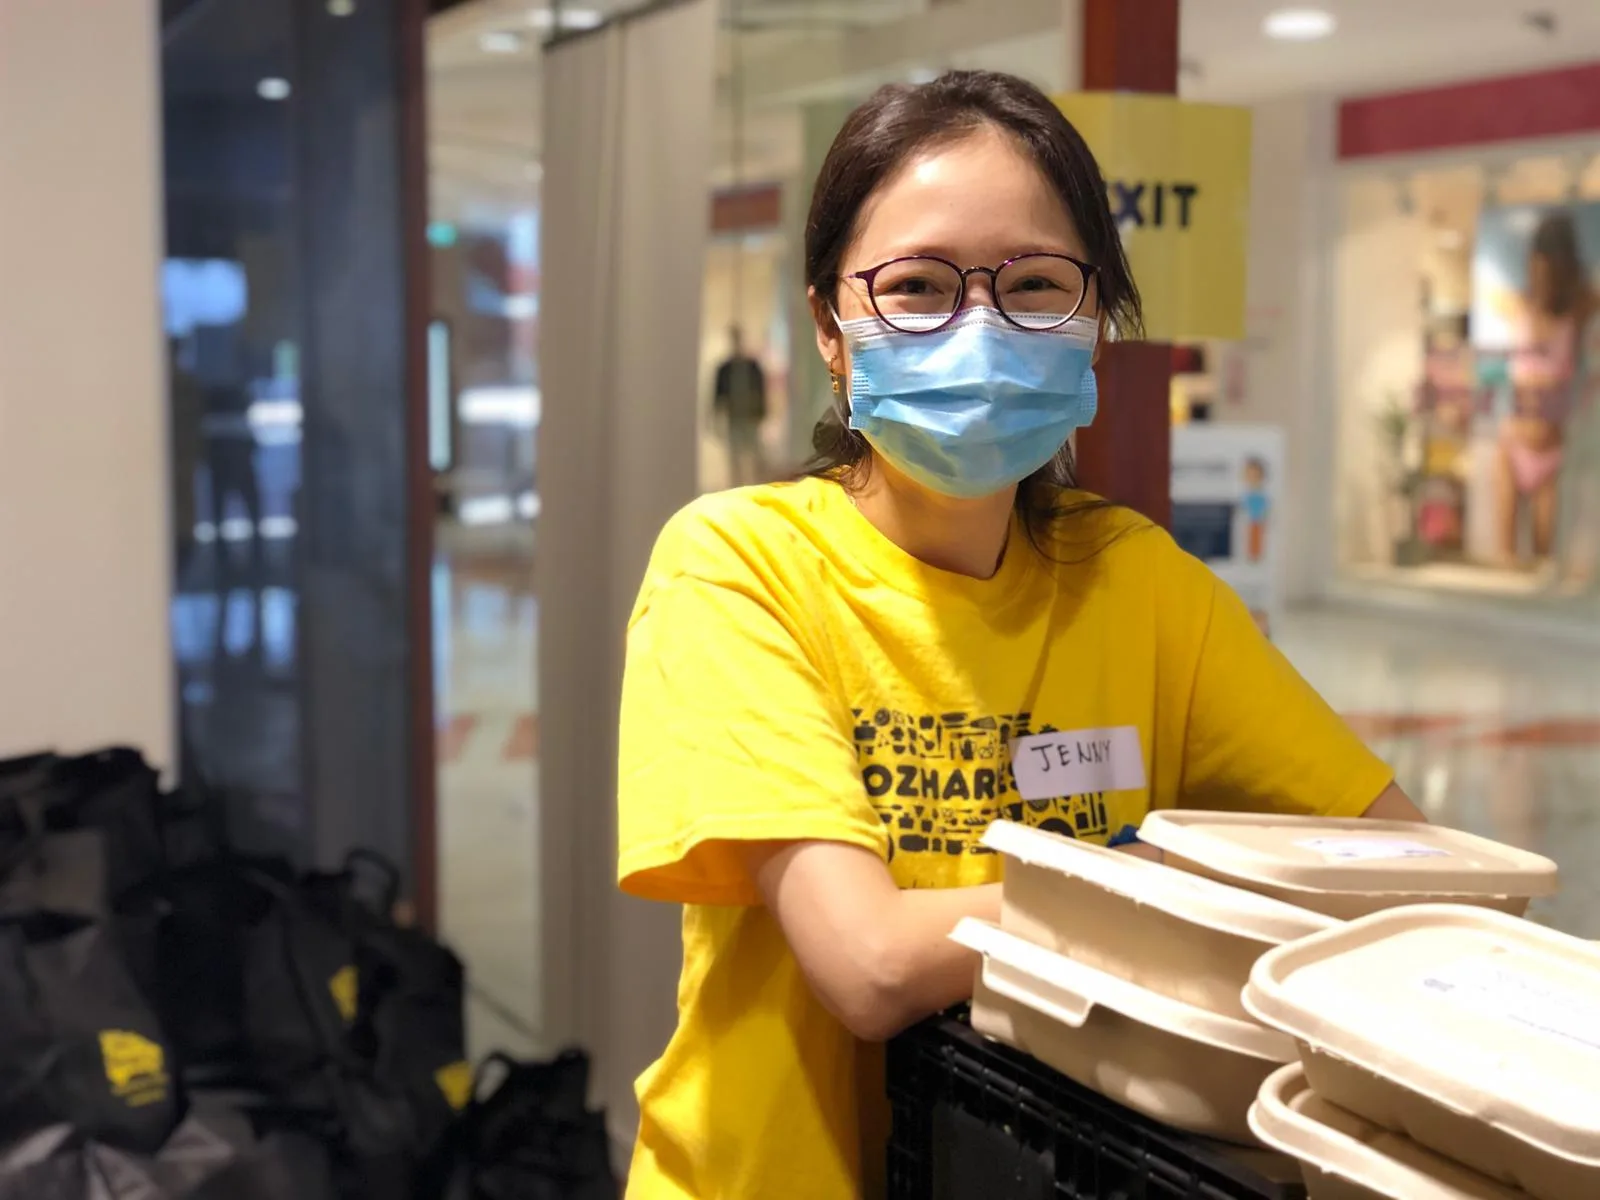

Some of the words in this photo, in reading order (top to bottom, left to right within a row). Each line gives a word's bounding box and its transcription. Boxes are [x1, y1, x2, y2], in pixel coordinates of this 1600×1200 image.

[1109, 181, 1199, 228] XIT
[1030, 739, 1111, 772] JENNY
[862, 763, 1016, 801] OZHAR
